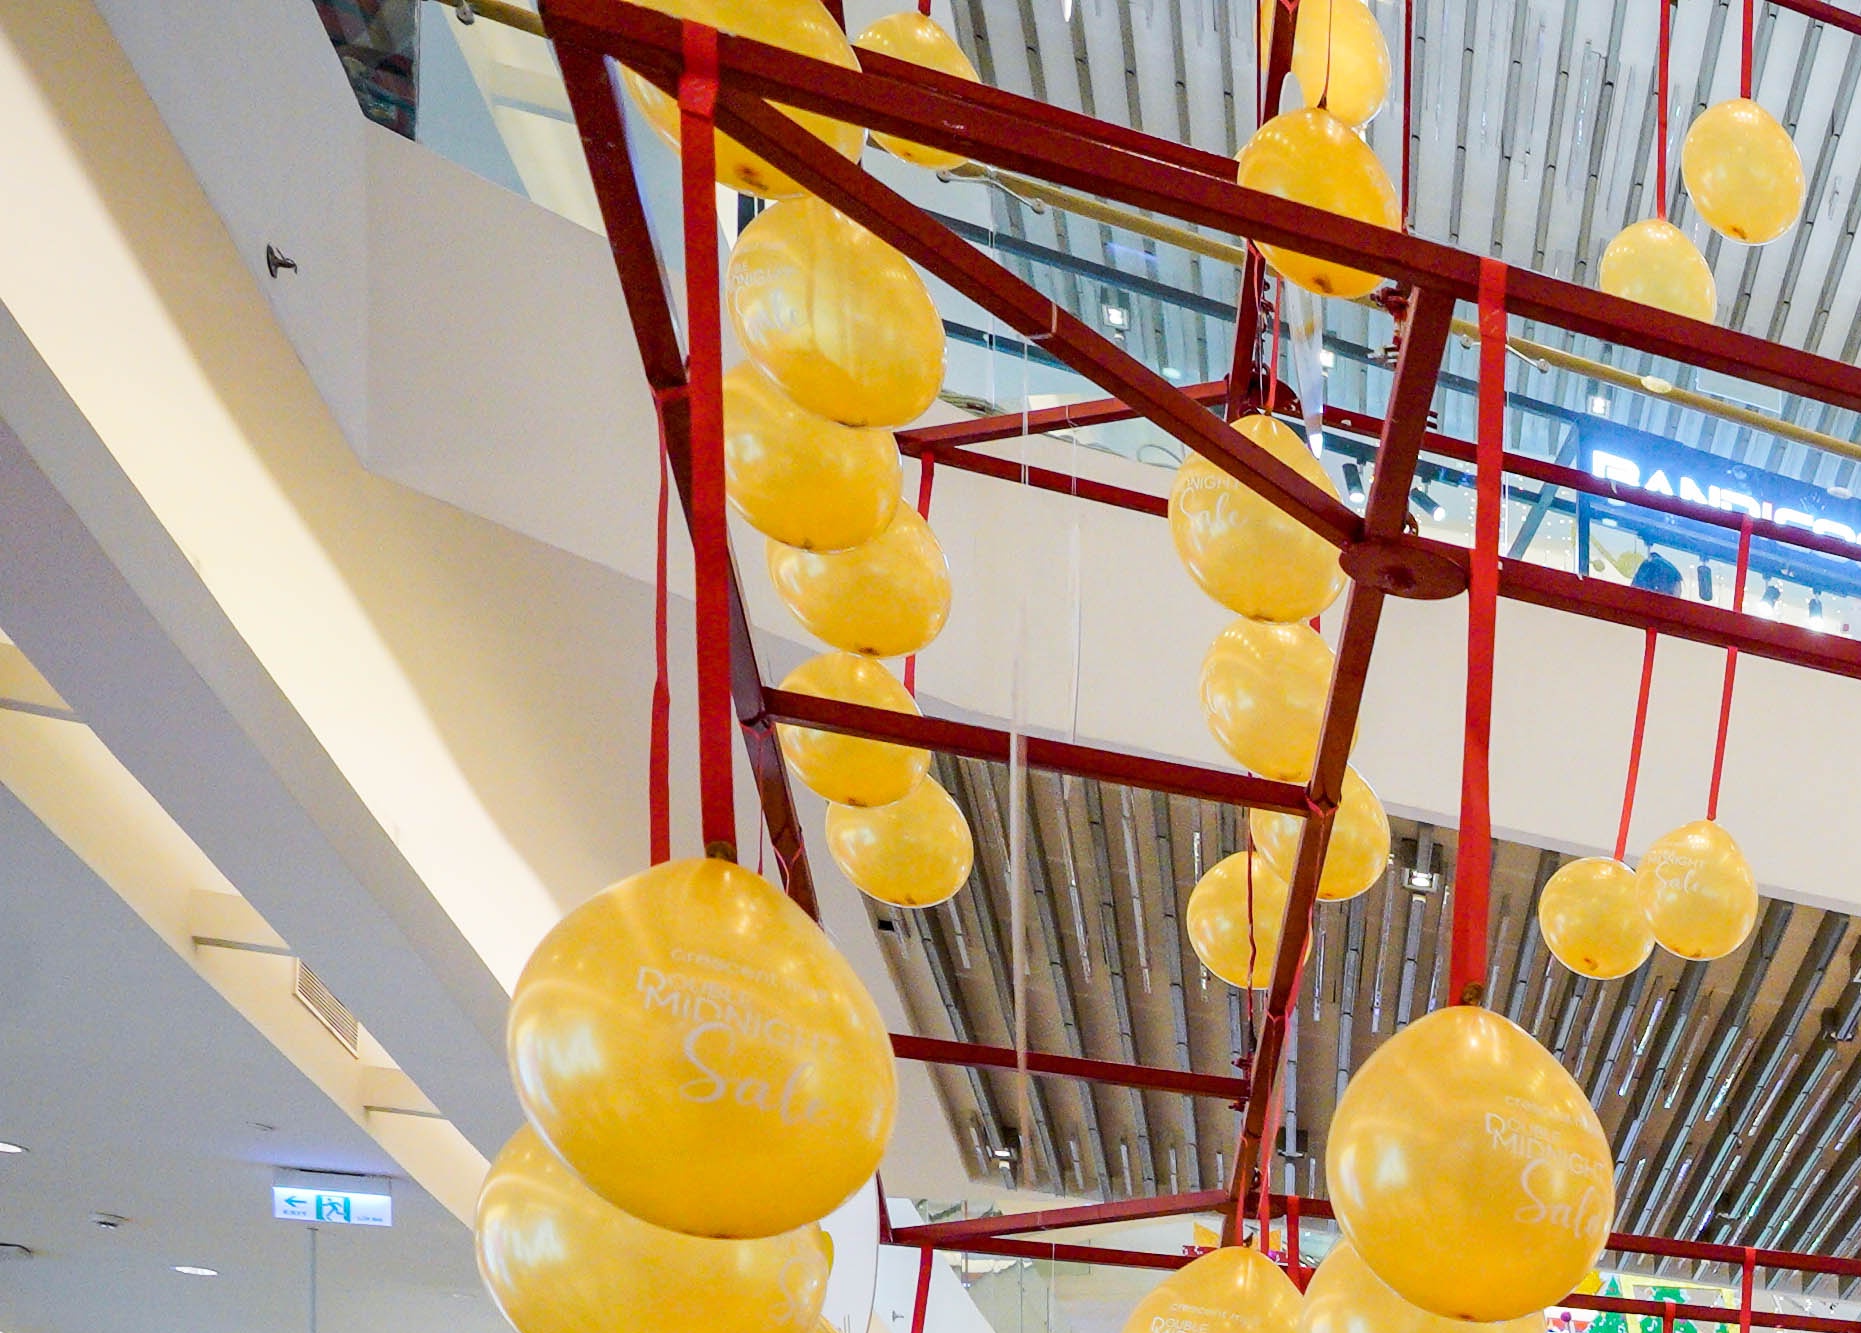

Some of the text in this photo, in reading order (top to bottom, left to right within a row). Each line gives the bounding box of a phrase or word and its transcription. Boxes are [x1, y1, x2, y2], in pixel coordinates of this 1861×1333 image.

[644, 986, 839, 1051] MIDNIGHT
[678, 1020, 837, 1121] Sale
[1515, 1157, 1603, 1240] Sale
